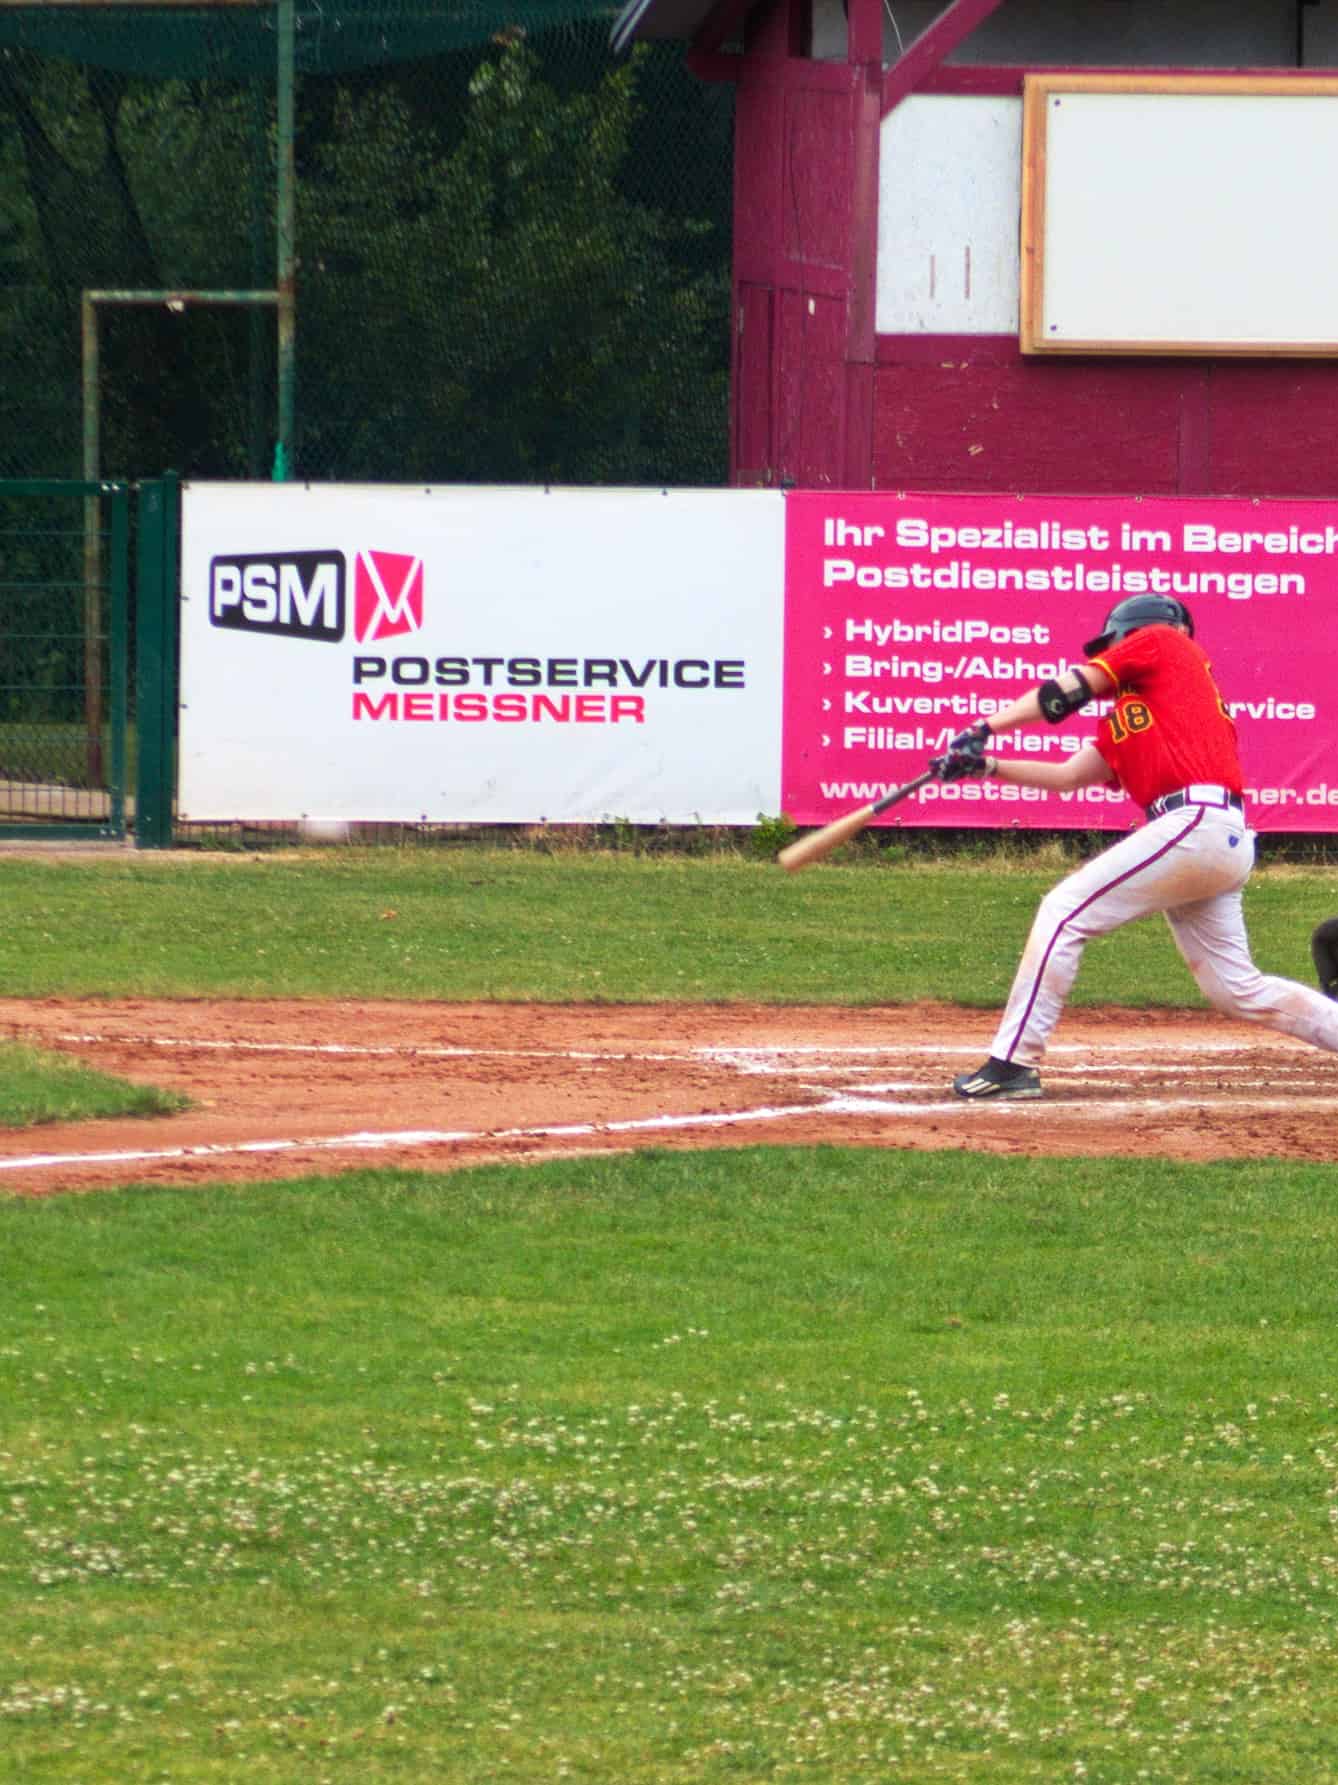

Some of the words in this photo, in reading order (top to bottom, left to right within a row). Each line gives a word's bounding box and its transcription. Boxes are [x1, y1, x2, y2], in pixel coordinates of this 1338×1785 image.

[823, 518, 885, 548] Ihr
[896, 519, 1110, 556] Spezialist
[1121, 523, 1171, 552] im
[213, 562, 338, 629] PSM
[823, 559, 1306, 599] Postdienstleistungen
[844, 618, 1051, 646] HybridPost
[352, 656, 746, 689] POSTSERVICE
[351, 692, 646, 724] MEISSNER
[1107, 701, 1153, 745] 18
